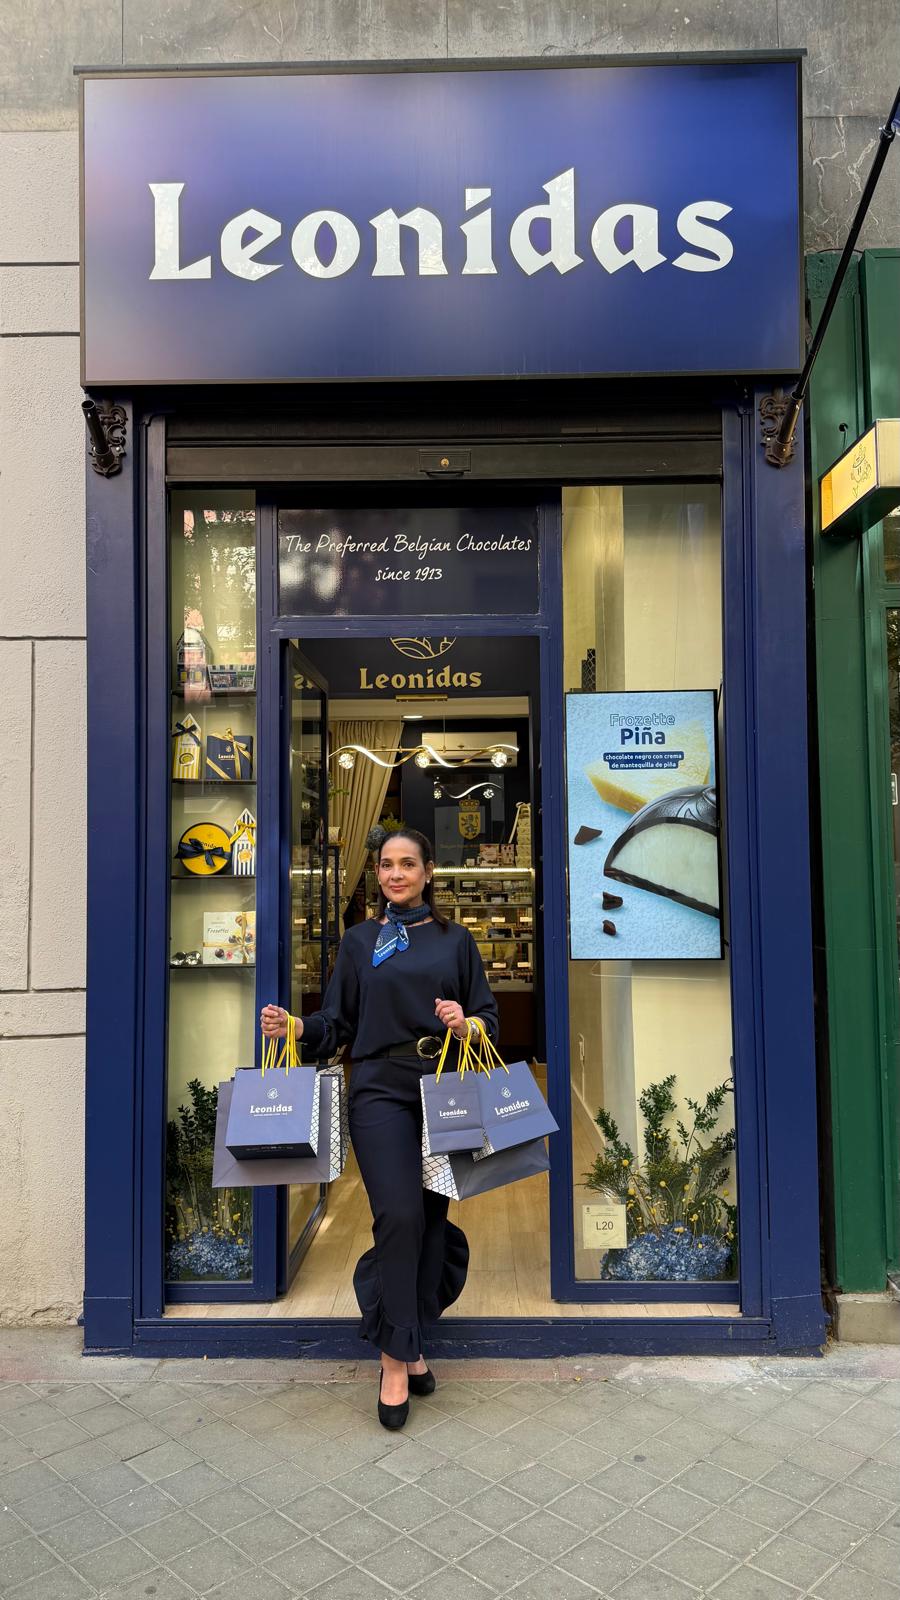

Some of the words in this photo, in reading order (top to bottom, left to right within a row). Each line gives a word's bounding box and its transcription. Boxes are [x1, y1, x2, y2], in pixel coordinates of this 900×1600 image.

[148, 167, 735, 281] Leonidas
[286, 535, 311, 553] The
[315, 534, 389, 558] Preferred
[393, 534, 452, 559] Belgian
[456, 533, 532, 552] Chocolates
[375, 568, 410, 582] since
[414, 567, 443, 581] 1913
[359, 665, 482, 690] Leonidas
[609, 712, 676, 727] Frozette
[620, 726, 666, 745] Piña
[249, 1103, 293, 1114] Leonidas
[439, 1108, 468, 1117] Leonidas
[494, 1099, 530, 1116] Leonidas
[595, 1221, 614, 1231] L20
